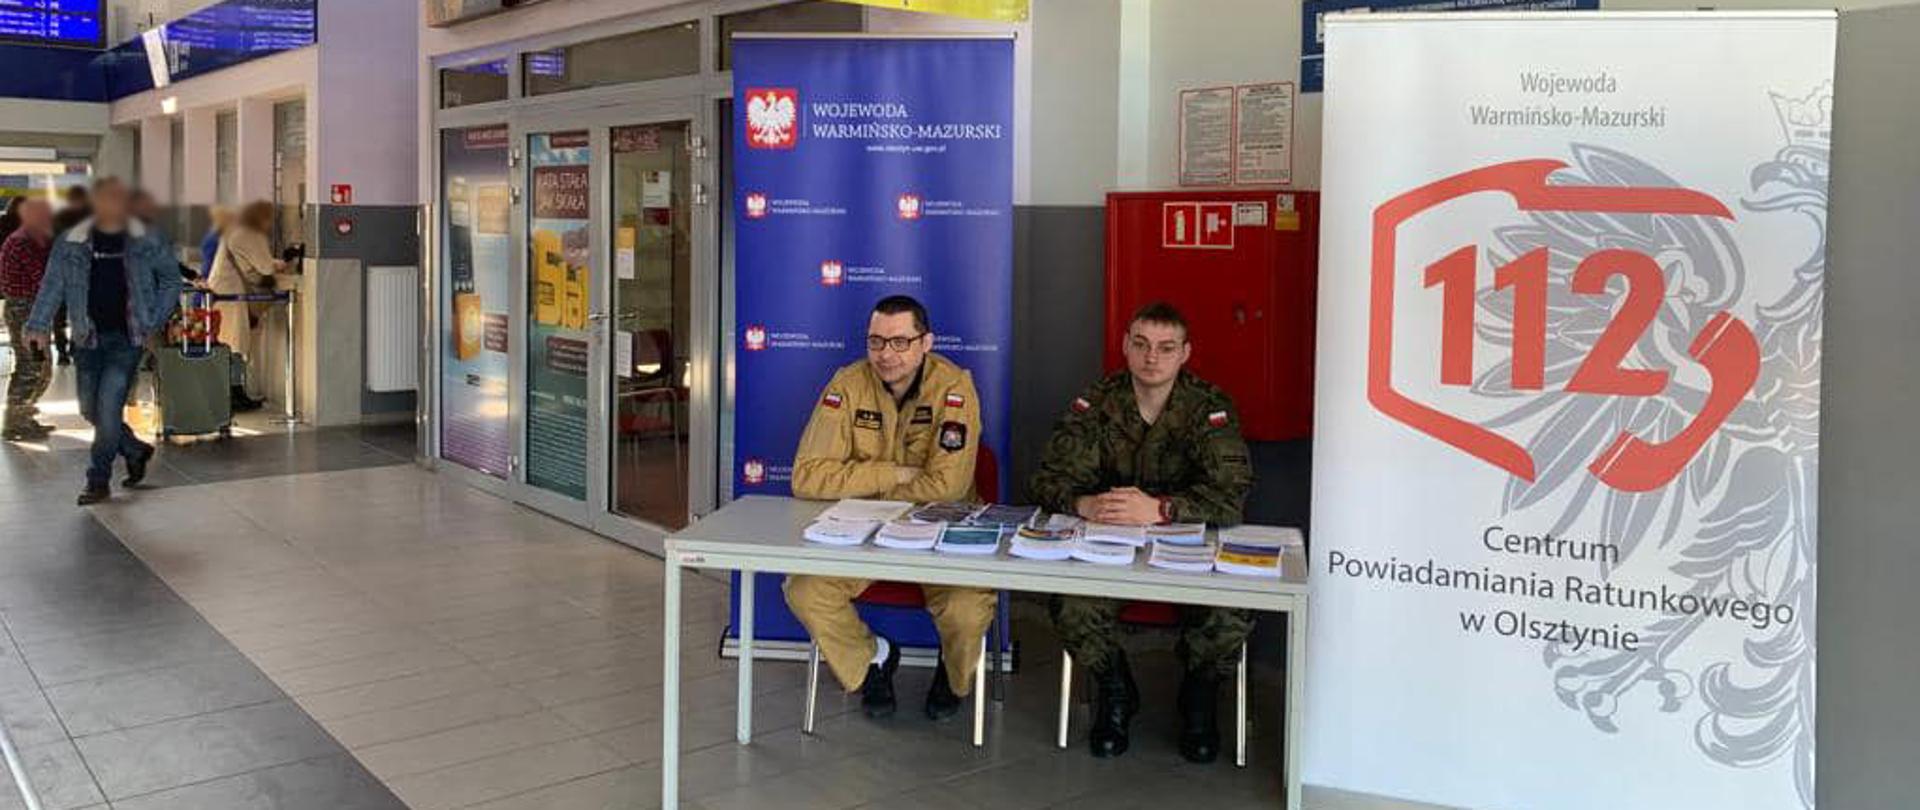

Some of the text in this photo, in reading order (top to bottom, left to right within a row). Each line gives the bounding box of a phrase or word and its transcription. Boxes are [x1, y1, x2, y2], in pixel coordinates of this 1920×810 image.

[1520, 71, 1617, 97] Wojewoda
[812, 103, 908, 118] WOJEWODA
[1469, 105, 1666, 129] Warmińsko-Mazurski
[812, 122, 1002, 140] WARMIŃSKO-MAZURSKI
[1424, 244, 1670, 396] 112
[1483, 525, 1620, 564] Centrum
[1328, 551, 1795, 629] Powiadamiania Ratunkowego
[1460, 609, 1640, 653] w Olsztynie
